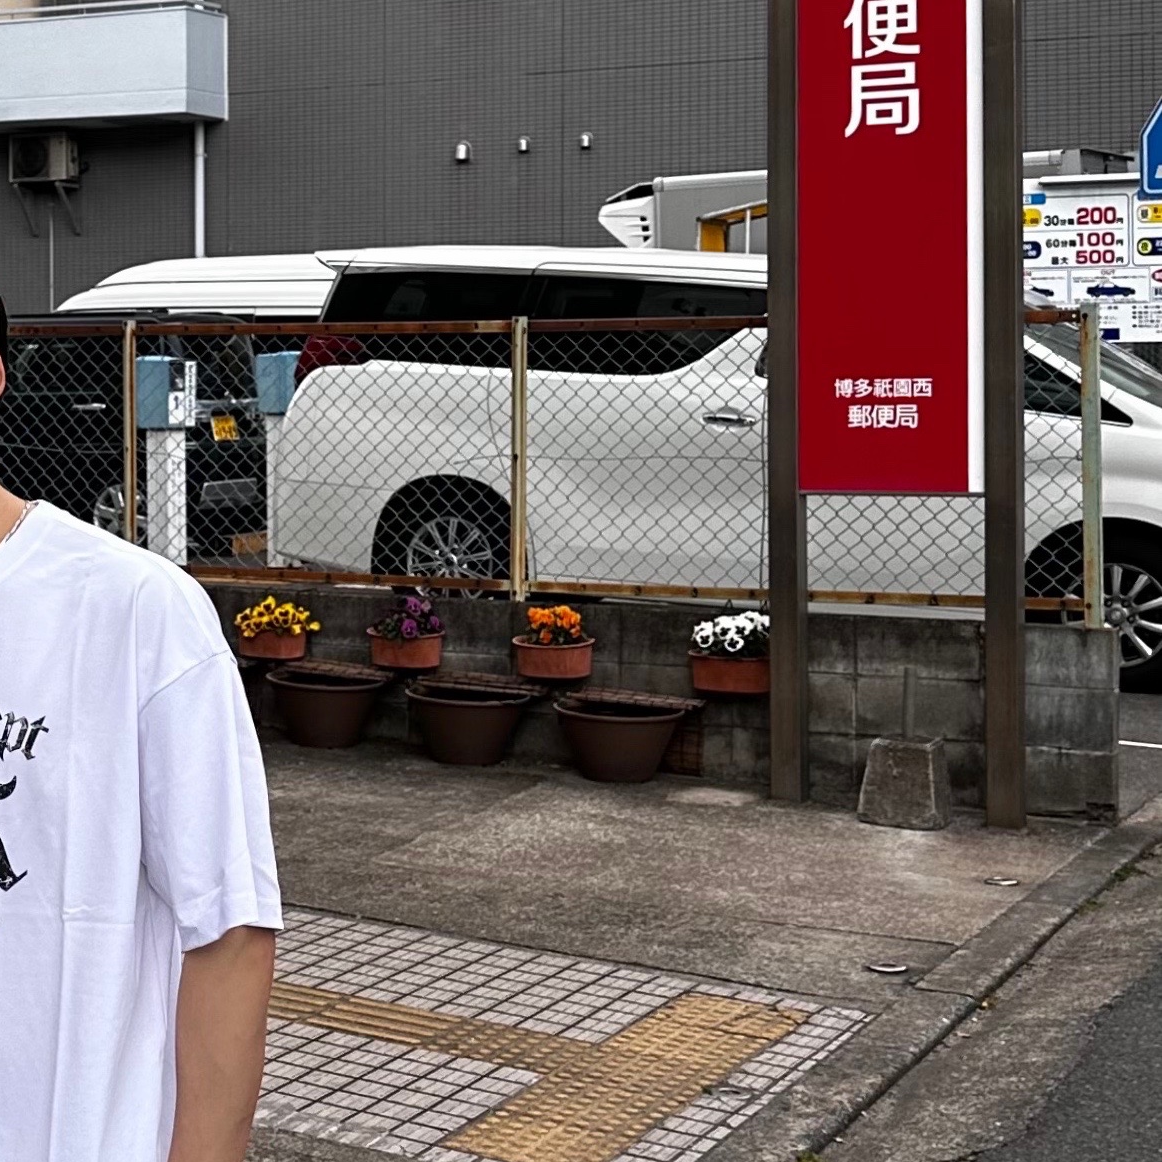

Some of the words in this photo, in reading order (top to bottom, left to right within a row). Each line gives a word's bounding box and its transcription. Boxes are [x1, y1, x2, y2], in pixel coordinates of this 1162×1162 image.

[834, 378, 933, 398] 博多祇園西
[847, 404, 919, 428] 郵便局
